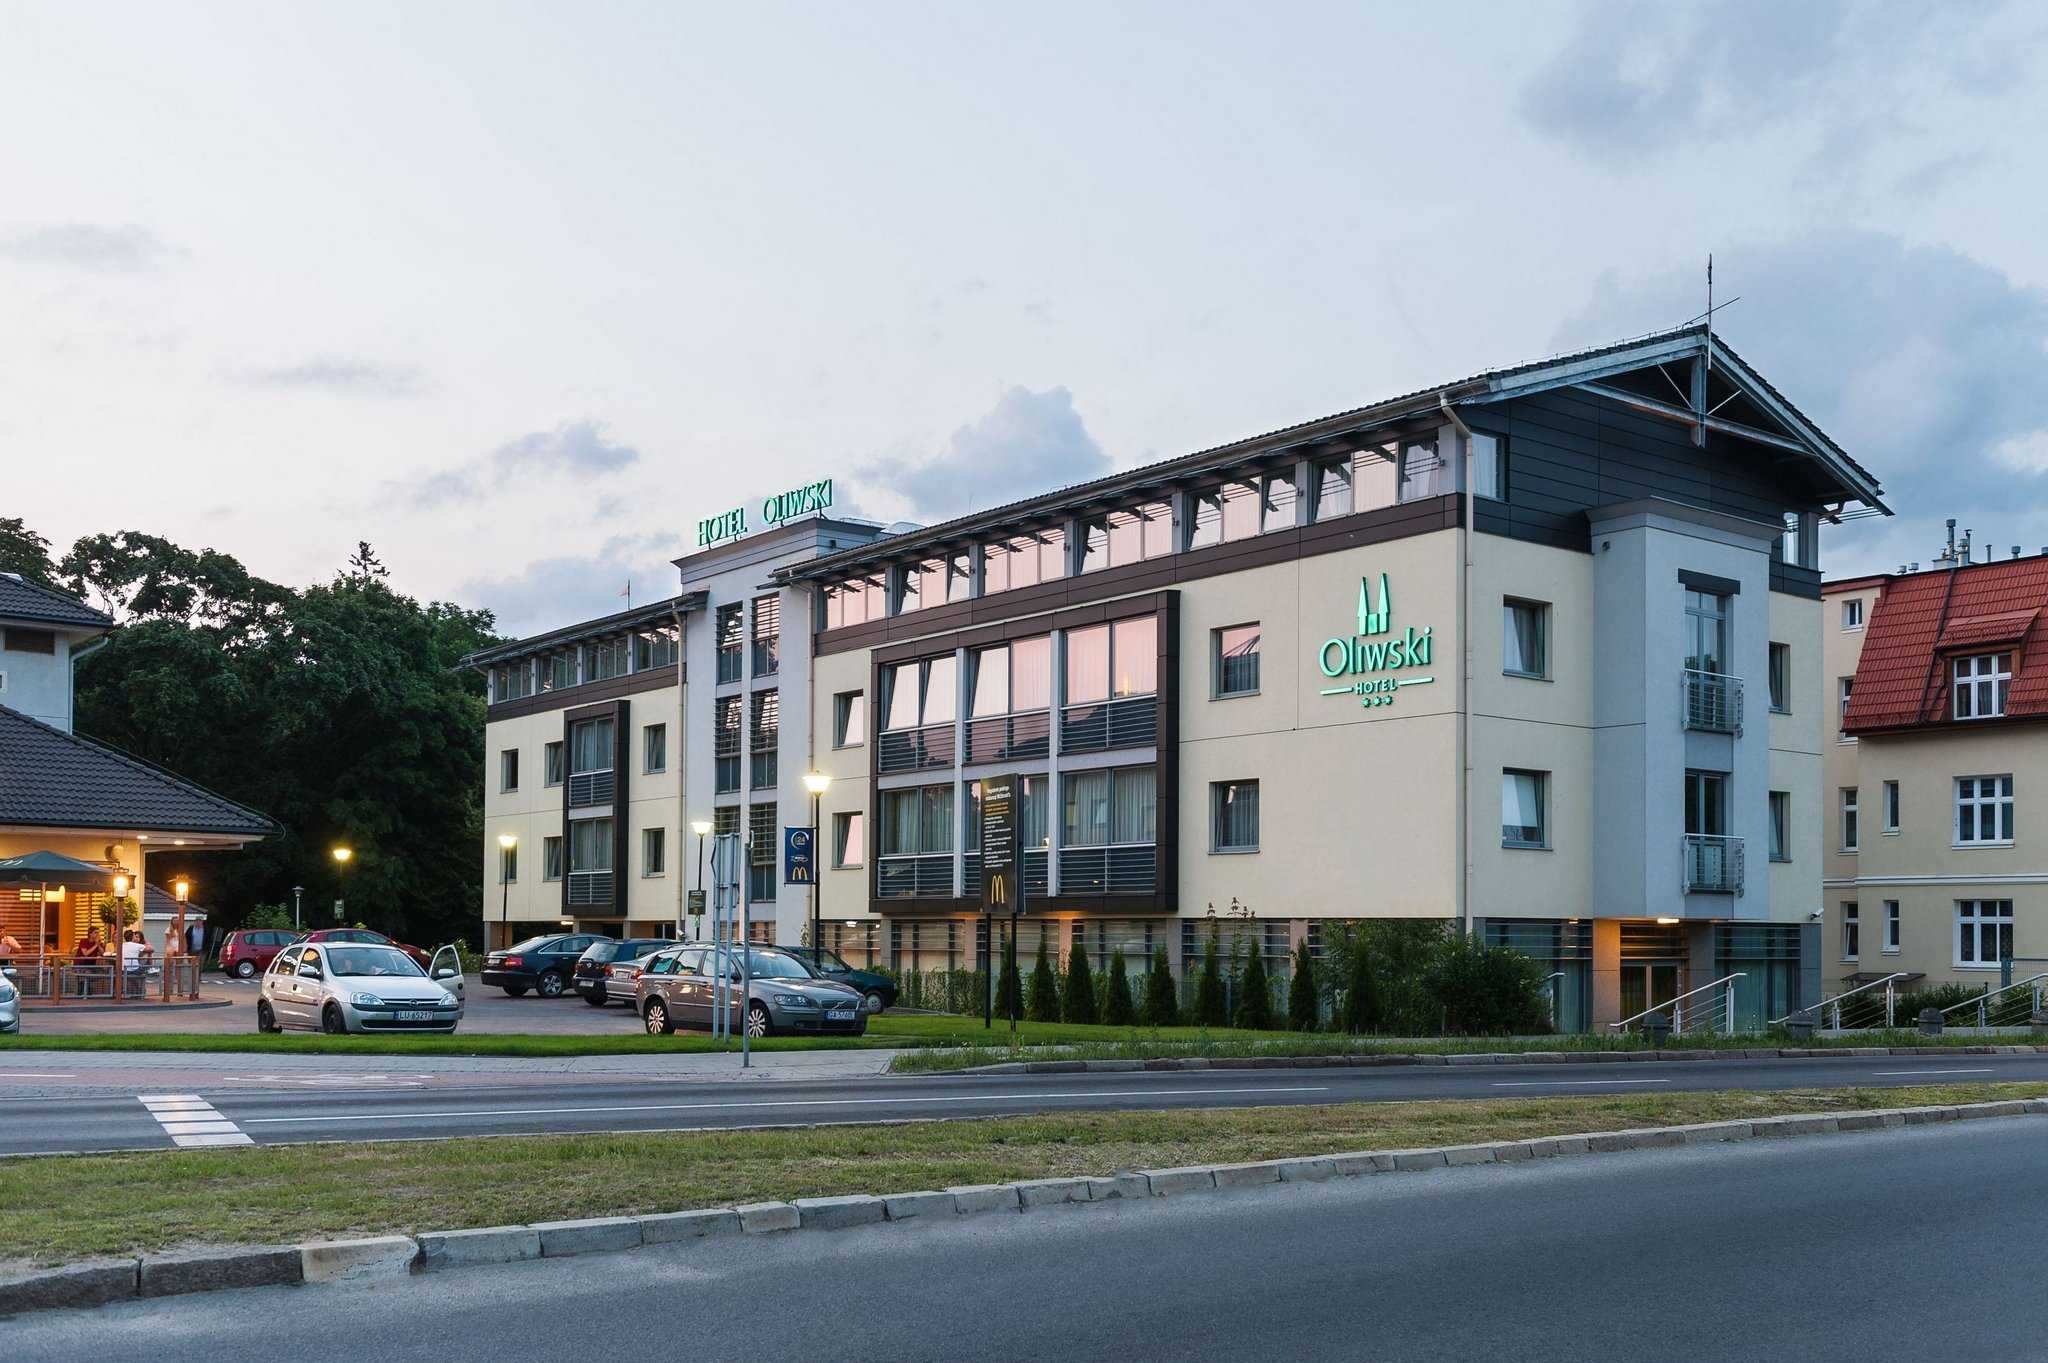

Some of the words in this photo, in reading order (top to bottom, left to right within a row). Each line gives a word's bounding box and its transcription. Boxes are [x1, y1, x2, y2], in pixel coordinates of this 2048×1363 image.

[698, 507, 748, 546] HOTEL
[763, 479, 833, 525] OLIWSKI
[1320, 626, 1432, 678] Oliwski
[1355, 679, 1398, 695] HOTEL
